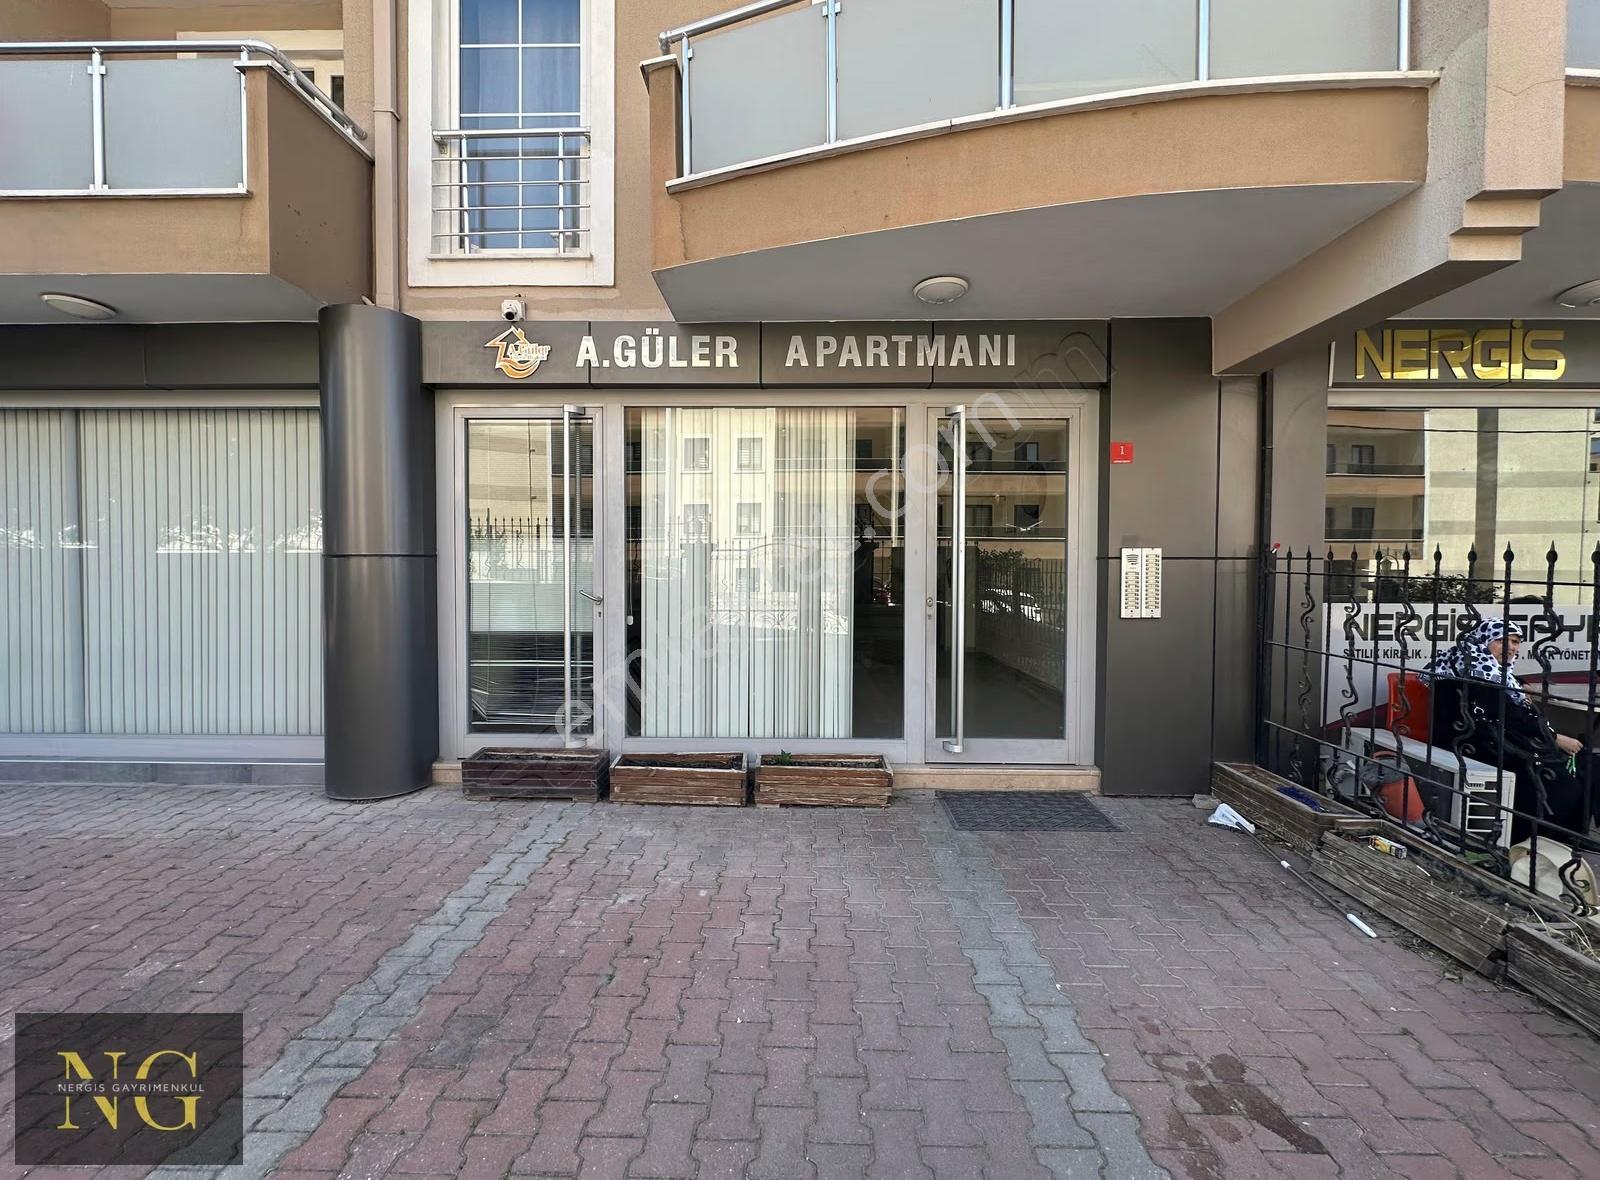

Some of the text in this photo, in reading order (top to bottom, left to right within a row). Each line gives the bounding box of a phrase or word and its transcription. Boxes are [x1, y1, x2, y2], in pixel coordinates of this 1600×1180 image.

[575, 327, 739, 368] A.GÜLER
[785, 334, 1016, 367] APARTMANI
[1355, 320, 1566, 380] NERGİS
[1119, 445, 1125, 455] 1
[1383, 647, 1422, 659] KİRLIK
